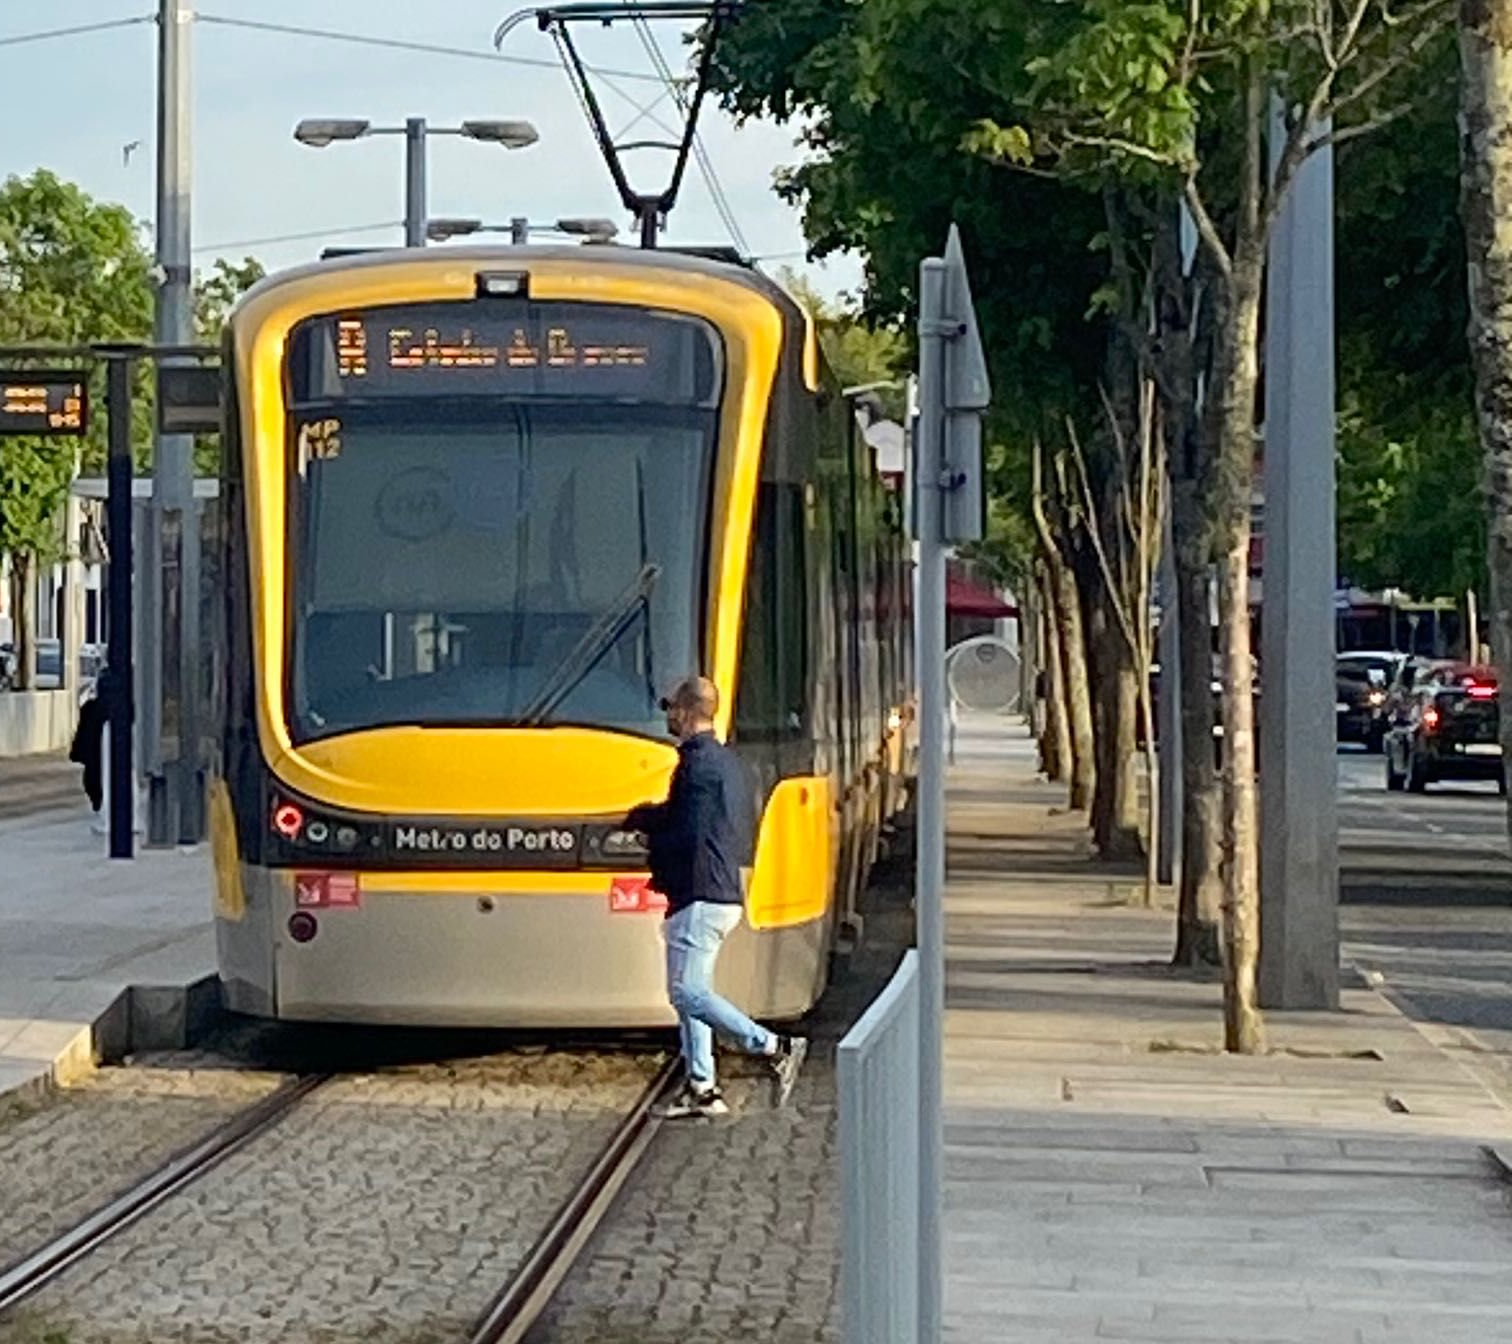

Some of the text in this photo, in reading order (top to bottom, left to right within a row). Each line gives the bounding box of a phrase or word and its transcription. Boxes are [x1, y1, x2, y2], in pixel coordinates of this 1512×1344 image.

[394, 827, 576, 850] Metro do Porto
